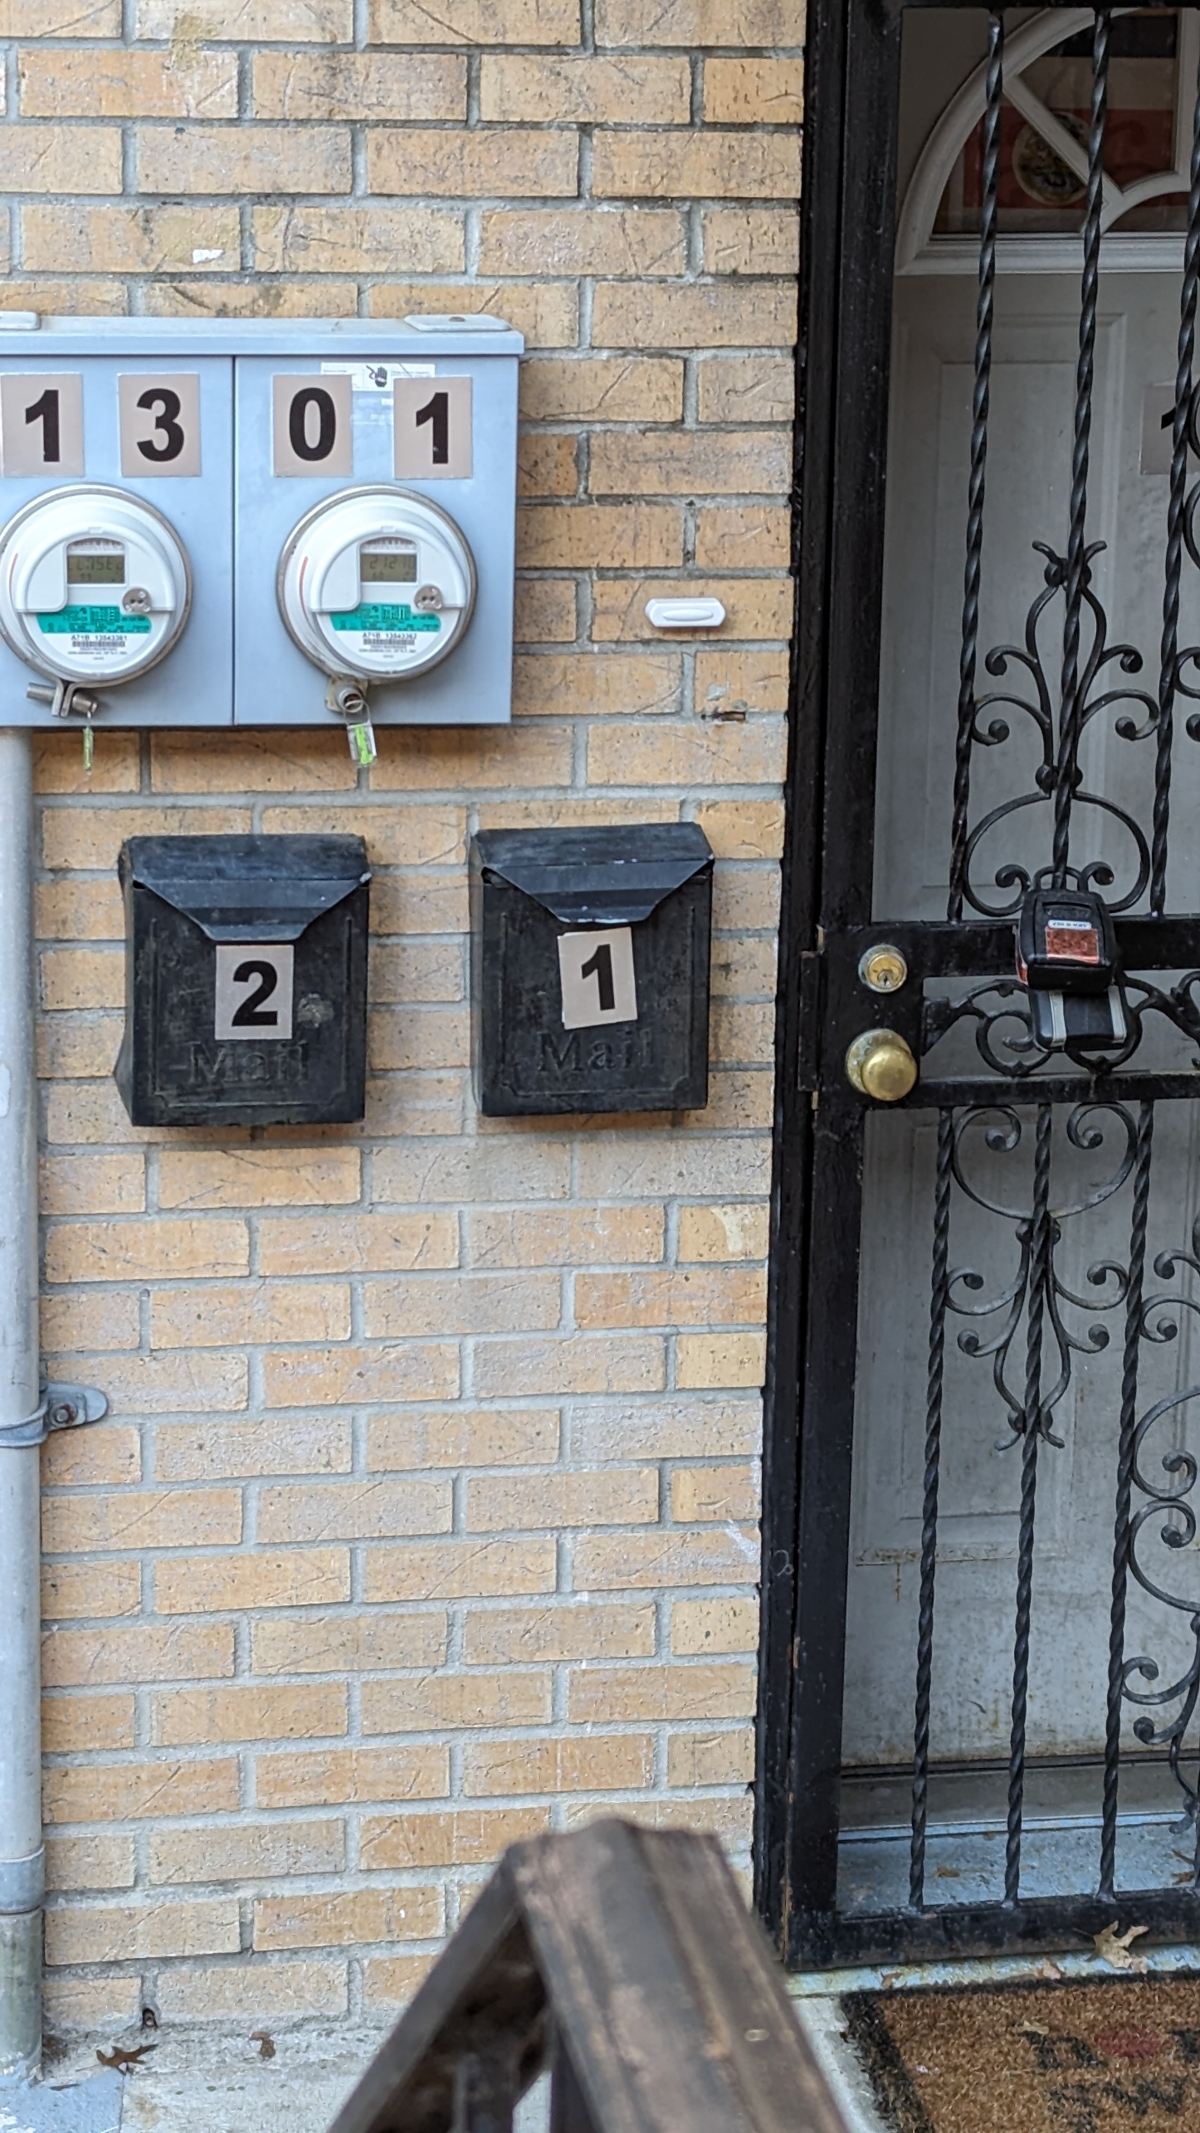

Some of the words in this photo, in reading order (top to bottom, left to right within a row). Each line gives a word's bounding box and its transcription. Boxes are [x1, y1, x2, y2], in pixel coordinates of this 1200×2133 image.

[25, 389, 60, 462] 1
[136, 388, 185, 462] 3
[289, 387, 336, 461] 0
[416, 392, 448, 464] 1
[231, 960, 278, 1027] 2
[581, 943, 615, 1011] 1
